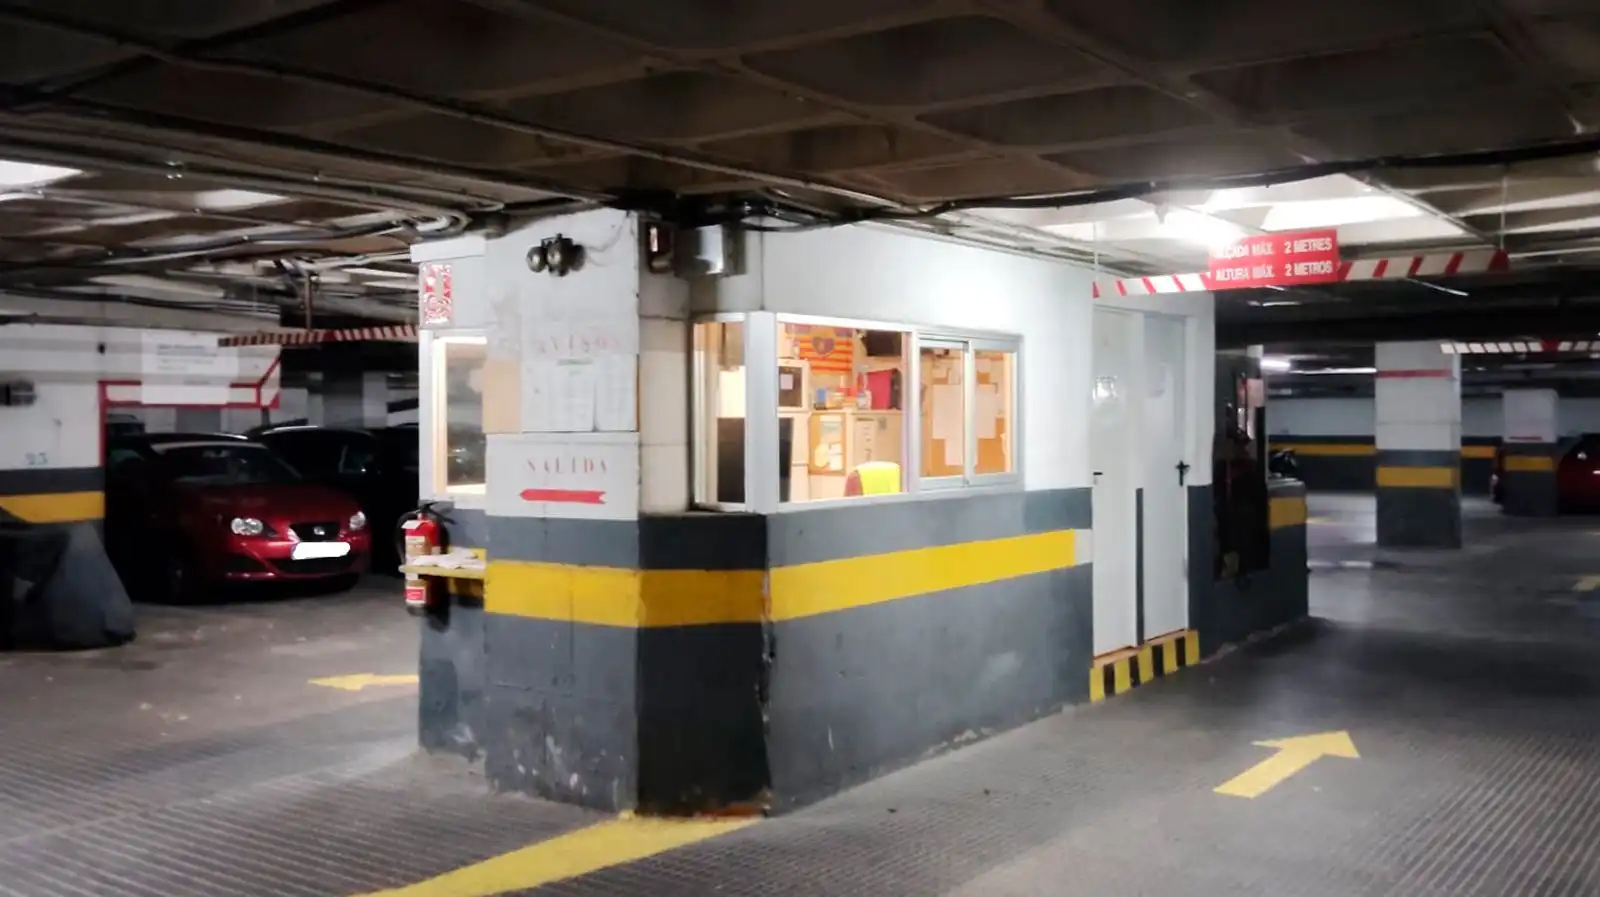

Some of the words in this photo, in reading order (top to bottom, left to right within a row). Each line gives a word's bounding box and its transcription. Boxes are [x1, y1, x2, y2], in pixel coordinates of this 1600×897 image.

[1284, 241, 1292, 255] 2
[1293, 237, 1333, 253] METRES
[1215, 267, 1249, 281] ALTURA
[1284, 263, 1292, 277] 2
[1293, 260, 1334, 276] METROS
[525, 456, 608, 473] SALIDA
